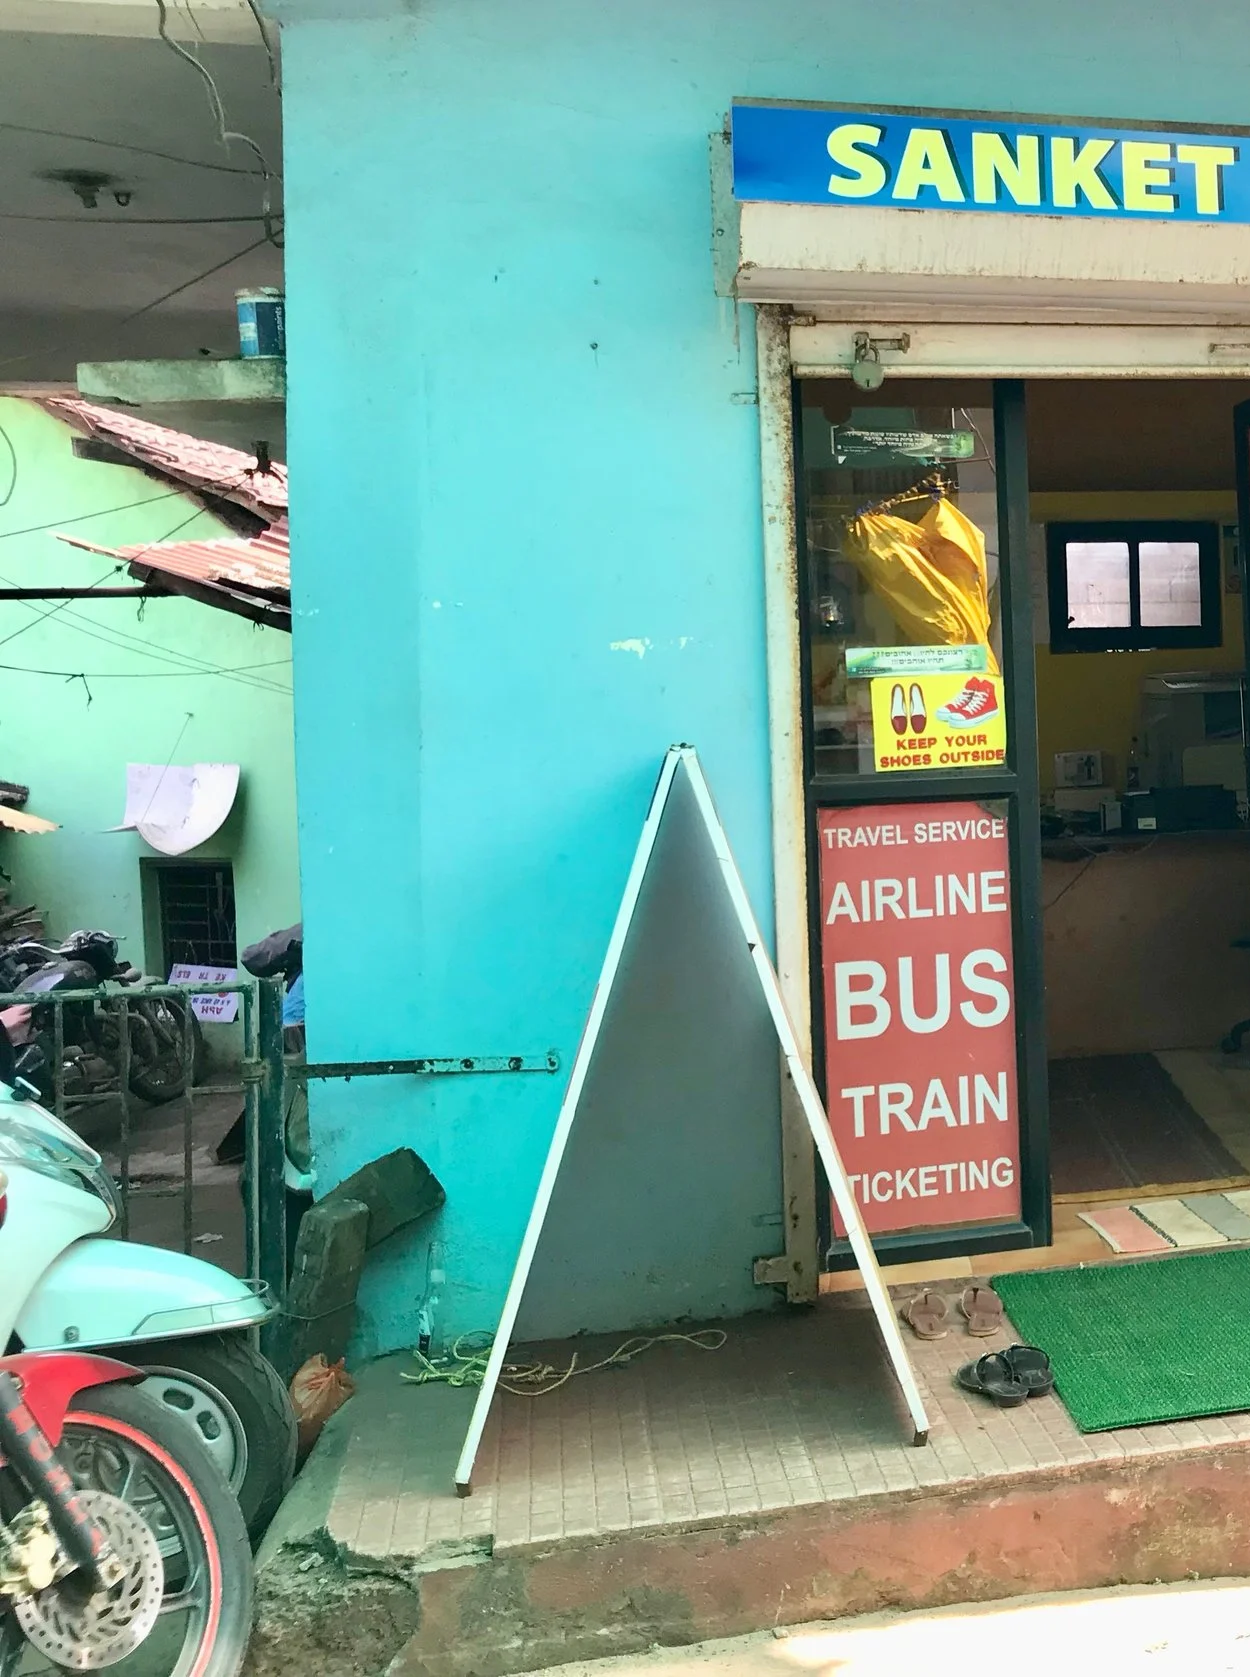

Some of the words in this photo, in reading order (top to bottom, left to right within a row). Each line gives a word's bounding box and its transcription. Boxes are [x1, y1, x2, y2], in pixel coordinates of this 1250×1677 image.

[826, 123, 1236, 215] SANKET
[880, 753, 932, 768] SHOES
[940, 749, 1005, 765] OUTSIDE
[896, 737, 938, 750] KEEP
[946, 734, 987, 748] YOUR
[824, 824, 908, 849] TRAVEL
[914, 818, 1004, 843] SERVICE
[826, 870, 1007, 926] AIRLINE
[835, 949, 1010, 1041] BUS
[841, 1072, 1009, 1138] TRAIN
[848, 1156, 1014, 1205] TICKETING
